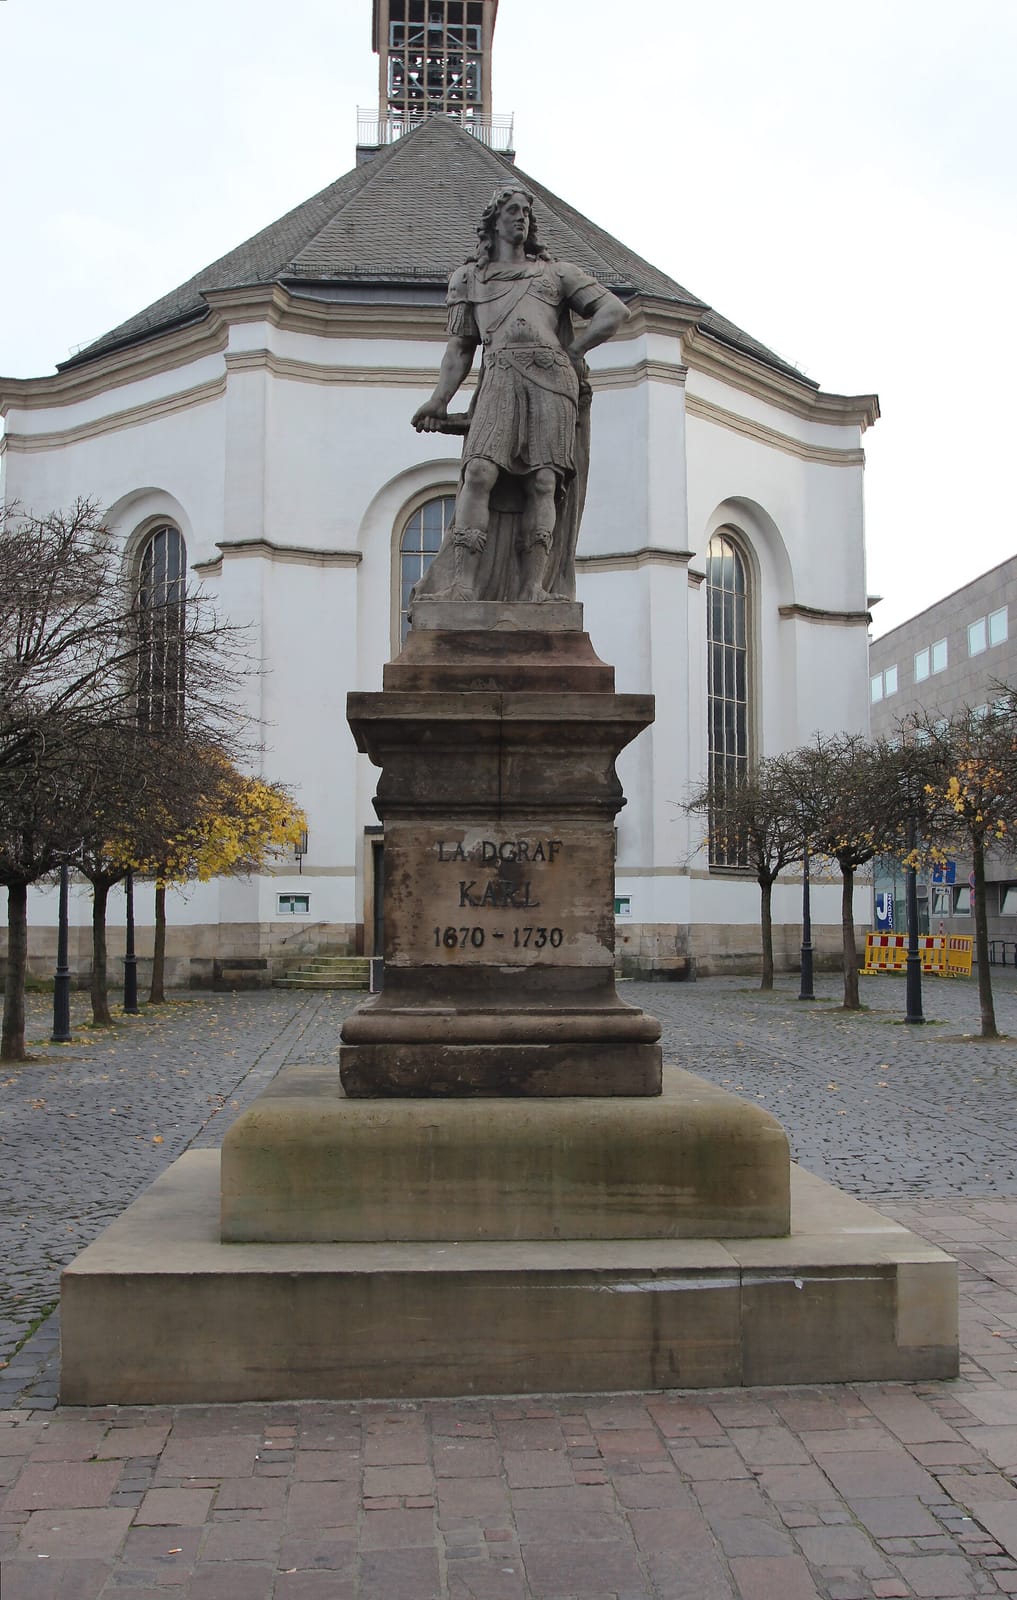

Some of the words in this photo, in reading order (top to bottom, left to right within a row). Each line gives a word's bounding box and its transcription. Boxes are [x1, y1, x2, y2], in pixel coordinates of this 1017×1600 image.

[437, 840, 563, 862] LADGRAF
[458, 880, 540, 907] KARL
[434, 926, 485, 948] 1670
[513, 927, 564, 948] 1730
